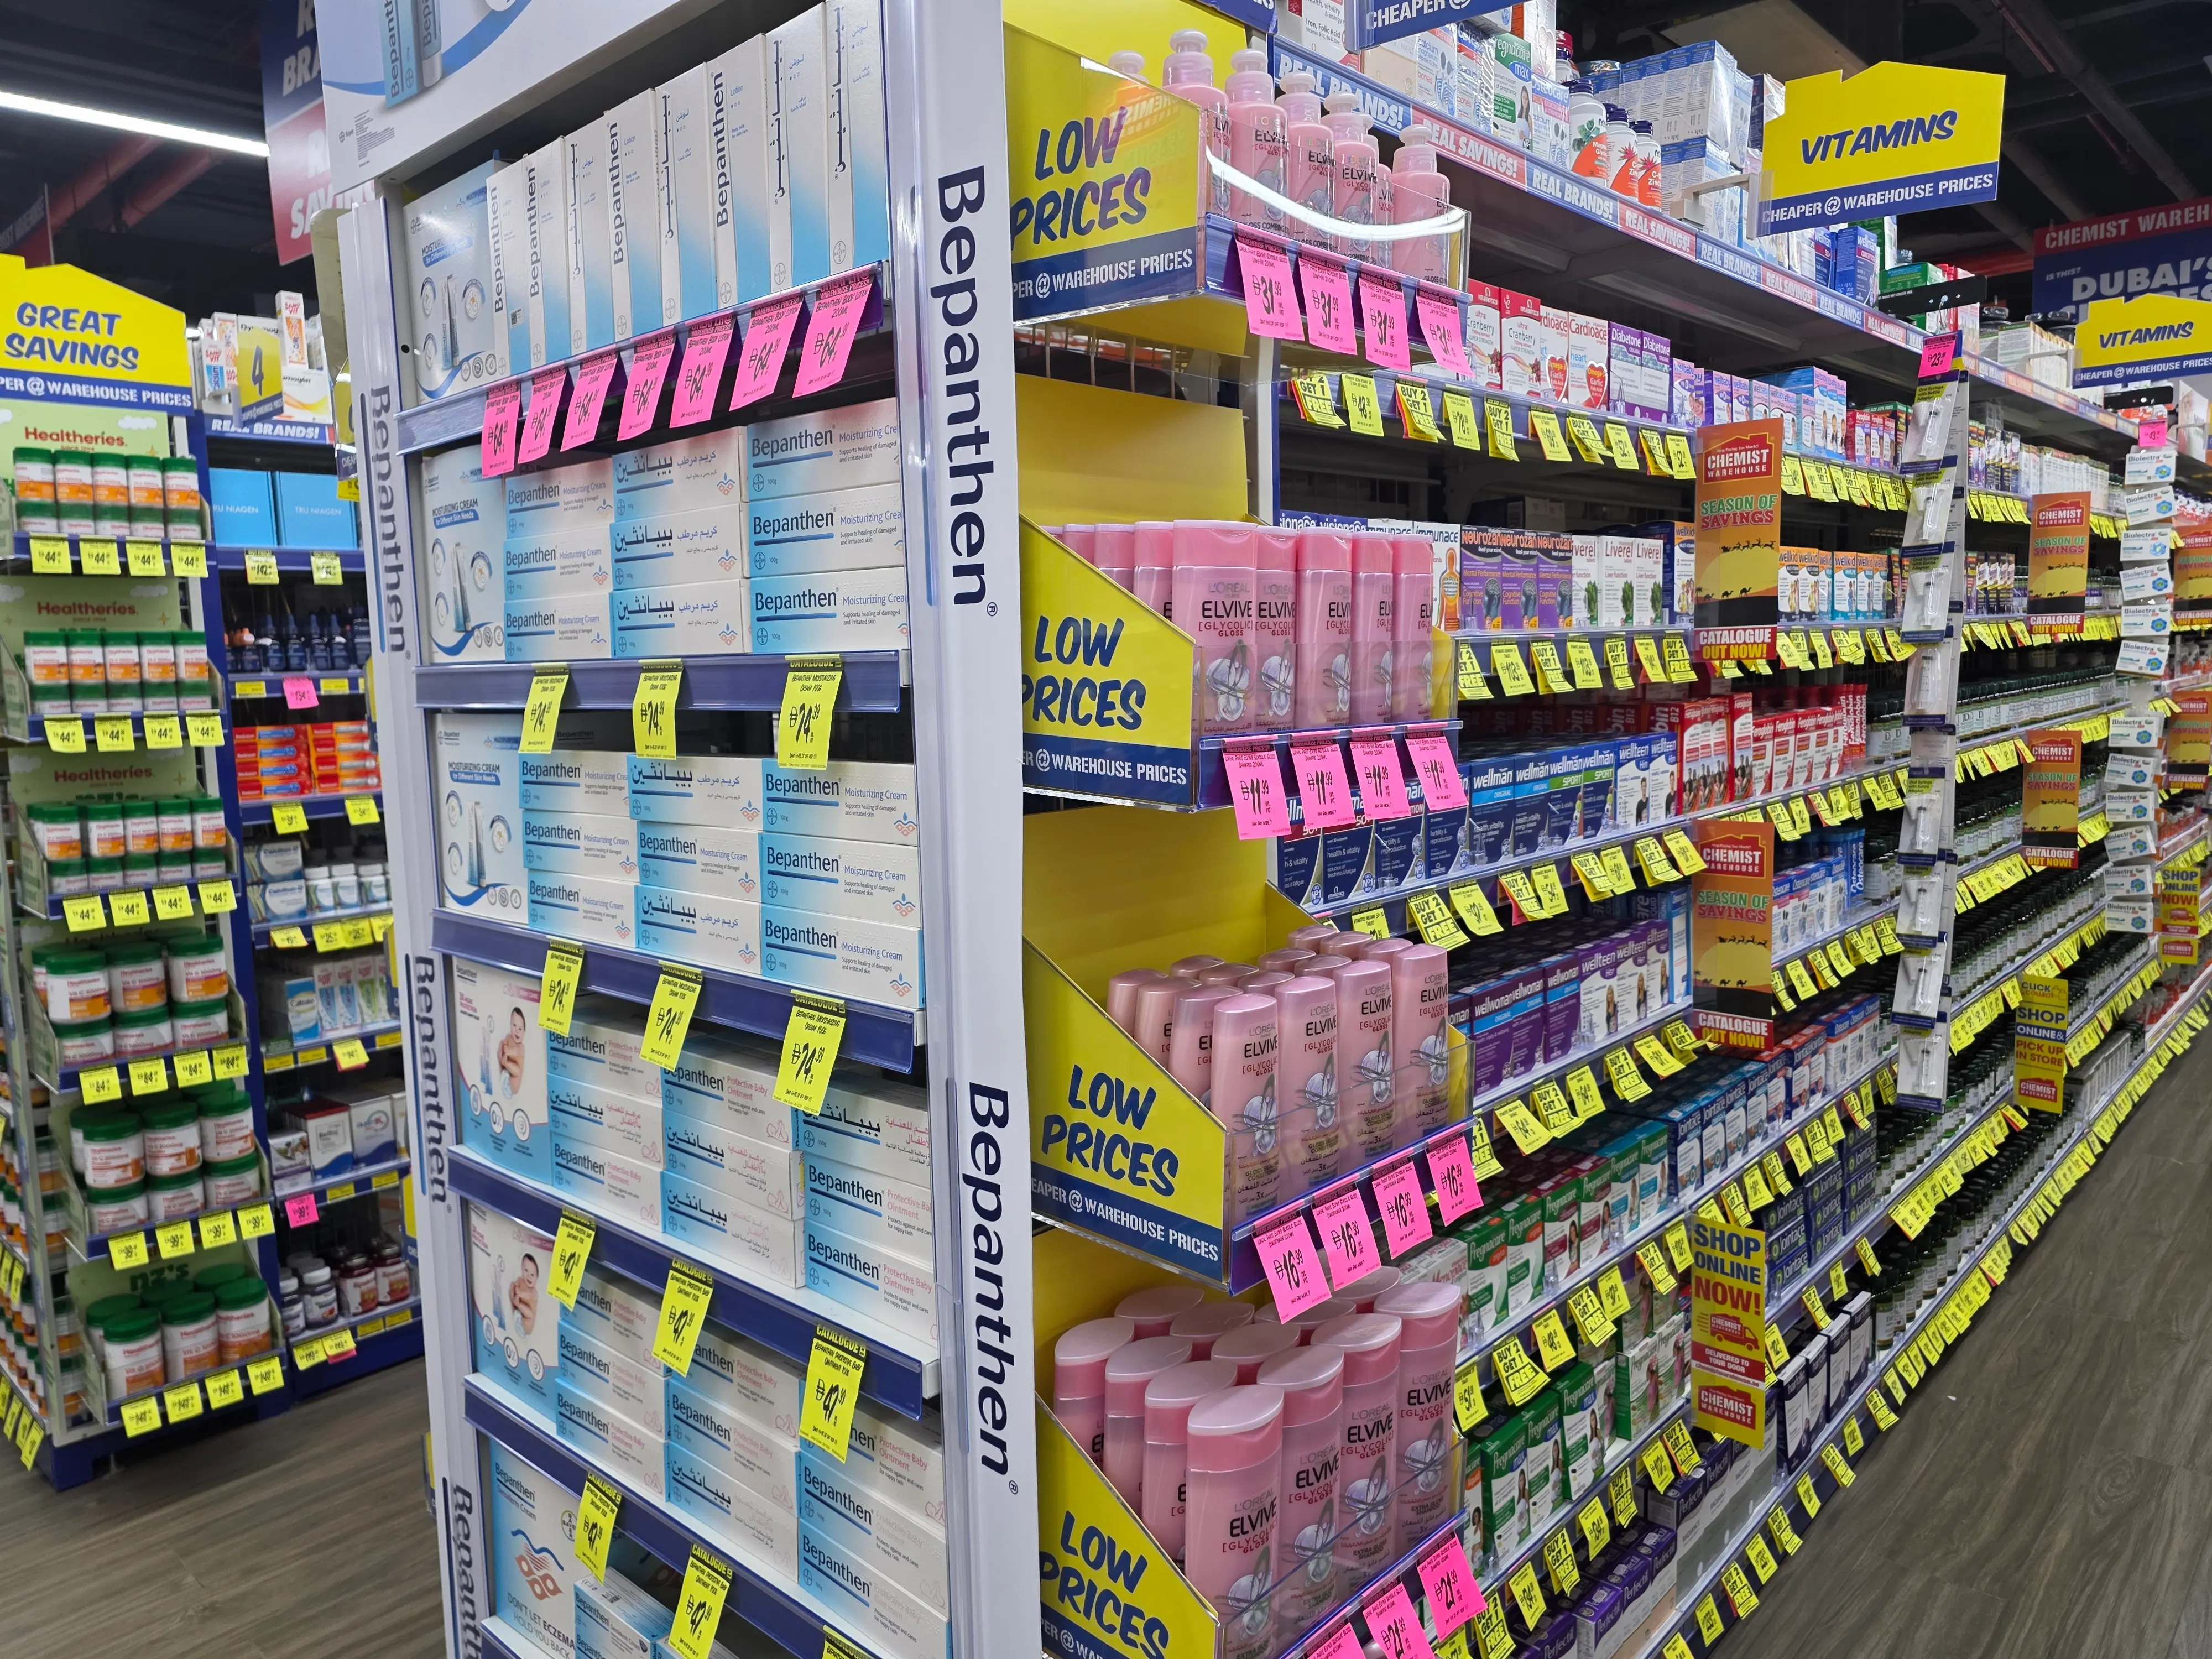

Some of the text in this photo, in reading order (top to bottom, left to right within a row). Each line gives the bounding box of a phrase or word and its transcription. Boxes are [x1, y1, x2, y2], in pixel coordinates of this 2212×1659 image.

[1306, 18, 1340, 38] Iron, Folic Acid
[1514, 64, 1530, 81] max
[1035, 106, 1128, 181] LOW
[1801, 109, 1958, 165] VITAMINS
[712, 71, 729, 227] Bepanthen
[1459, 135, 1517, 178] SAVINGS!
[608, 122, 624, 265] Bepanthen
[1532, 170, 1613, 220] REAL BRANDS!
[1762, 202, 1822, 223] CHEAPER
[1843, 182, 1934, 210] WAREHOUSE
[1938, 173, 1994, 195] PRICES
[1010, 166, 1151, 252] PRICES
[527, 166, 539, 298] Bepanthen
[1625, 210, 1690, 252] REAL SAVINGS!
[2046, 219, 2129, 249] CHEMIST
[1052, 259, 1136, 293] WAREHOUSE
[1140, 248, 1193, 277] PRICES
[1701, 242, 1758, 280] REAL BRANDS!
[1766, 271, 1783, 292] REAL
[2056, 267, 2081, 278] THIS?
[1820, 295, 1835, 314] REAL
[17, 302, 122, 336] GREAT
[1569, 318, 1607, 341] Cardioace
[1509, 327, 1535, 346] Cranberry
[1611, 327, 1641, 348] Diabetone
[2099, 321, 2194, 349] VITAMINS
[4, 333, 139, 371] SAVINGS
[1643, 336, 1670, 356] Diabetone
[1570, 351, 1587, 363] heart
[2075, 357, 2212, 381] CHEAPER WAREHOUSE PRICES
[930, 165, 994, 605] Bepanthen
[1590, 378, 1604, 386] Garlic
[46, 380, 191, 407] WAREHOUSE PRICES
[25, 427, 125, 446] Healtheries
[253, 423, 319, 439] BRANDS!
[752, 427, 883, 459] Bepanthen Moisturizing
[839, 447, 857, 455] Supports
[858, 445, 872, 453] healing
[1708, 448, 1770, 469] CHEMIST
[2128, 454, 2161, 463] Biolectra
[1708, 465, 1767, 478] WAREHOUSE
[508, 484, 560, 506] Bepanthen
[1700, 494, 1778, 517] SEASON OF
[753, 510, 883, 538] Bepanthen Moisturizing
[1701, 510, 1774, 531] SAVINGS
[2039, 508, 2083, 521] CHEMIST
[506, 547, 556, 568] Bepanthen
[1605, 542, 1632, 558] Liverel
[1202, 600, 1253, 618] ELVIVE
[2030, 615, 2081, 625] CATALOGUE
[1034, 614, 1124, 667] LOW
[1699, 628, 1771, 645] CATALOGUE
[1535, 646, 1555, 658] BUY 2
[1702, 643, 1767, 660] OUT NOW!
[1541, 658, 1552, 667] GET
[1547, 670, 1564, 682] FREE
[1619, 742, 1649, 760] wellteen
[1052, 755, 1187, 786] WAREHOUSE PRICES
[1474, 767, 1512, 790] wellman
[1563, 775, 1582, 786] SPORT
[845, 787, 907, 801] Moisturizing Cream
[1494, 790, 1511, 799] ORIGINAL
[862, 803, 874, 811] healing
[844, 865, 906, 881] Moisturizing Cream
[2163, 868, 2199, 882] SHOP
[1415, 900, 1433, 915] BUY
[1698, 890, 1770, 910] SEASON OF
[2162, 893, 2198, 907] NOW!
[1428, 920, 1457, 941] FREE
[2021, 982, 2051, 992] CLICK
[1361, 995, 1391, 1015] ELVIVE
[2017, 1006, 2065, 1024] SHOP
[1306, 1015, 1337, 1036] ELVIVE
[1373, 1024, 1388, 1032] GLOSS
[1698, 1013, 1768, 1036] CATALOGUE
[2016, 1040, 2063, 1055] PICK UP
[2016, 1051, 2063, 1066] IN STORE
[1068, 1063, 1157, 1131] LOW
[1041, 1114, 1179, 1198] PRICES
[887, 1189, 920, 1208] Protective
[1546, 1188, 1577, 1214] Pregnacare
[888, 1201, 919, 1220] Ointment
[1084, 1198, 1165, 1243] WAREHOUSE
[1169, 1230, 1219, 1263] PRICES
[1694, 1223, 1761, 1260] SHOP
[1694, 1250, 1761, 1286] ONLINE
[884, 1276, 914, 1296] Ointment
[916, 1278, 932, 1294] Baby
[1694, 1275, 1761, 1316] NOW!
[1705, 1347, 1749, 1367] DELIVERED TO
[1407, 1376, 1451, 1406] ELVIVE
[1700, 1389, 1754, 1417] CHEMIST
[1347, 1411, 1393, 1443] ELVIVE
[1360, 1446, 1385, 1459] GLOSS
[1229, 1496, 1277, 1538] ELVIVE
[1060, 1509, 1149, 1594] LOW
[529, 1609, 541, 1625] LET
[543, 1621, 575, 1650] ECZEMA
